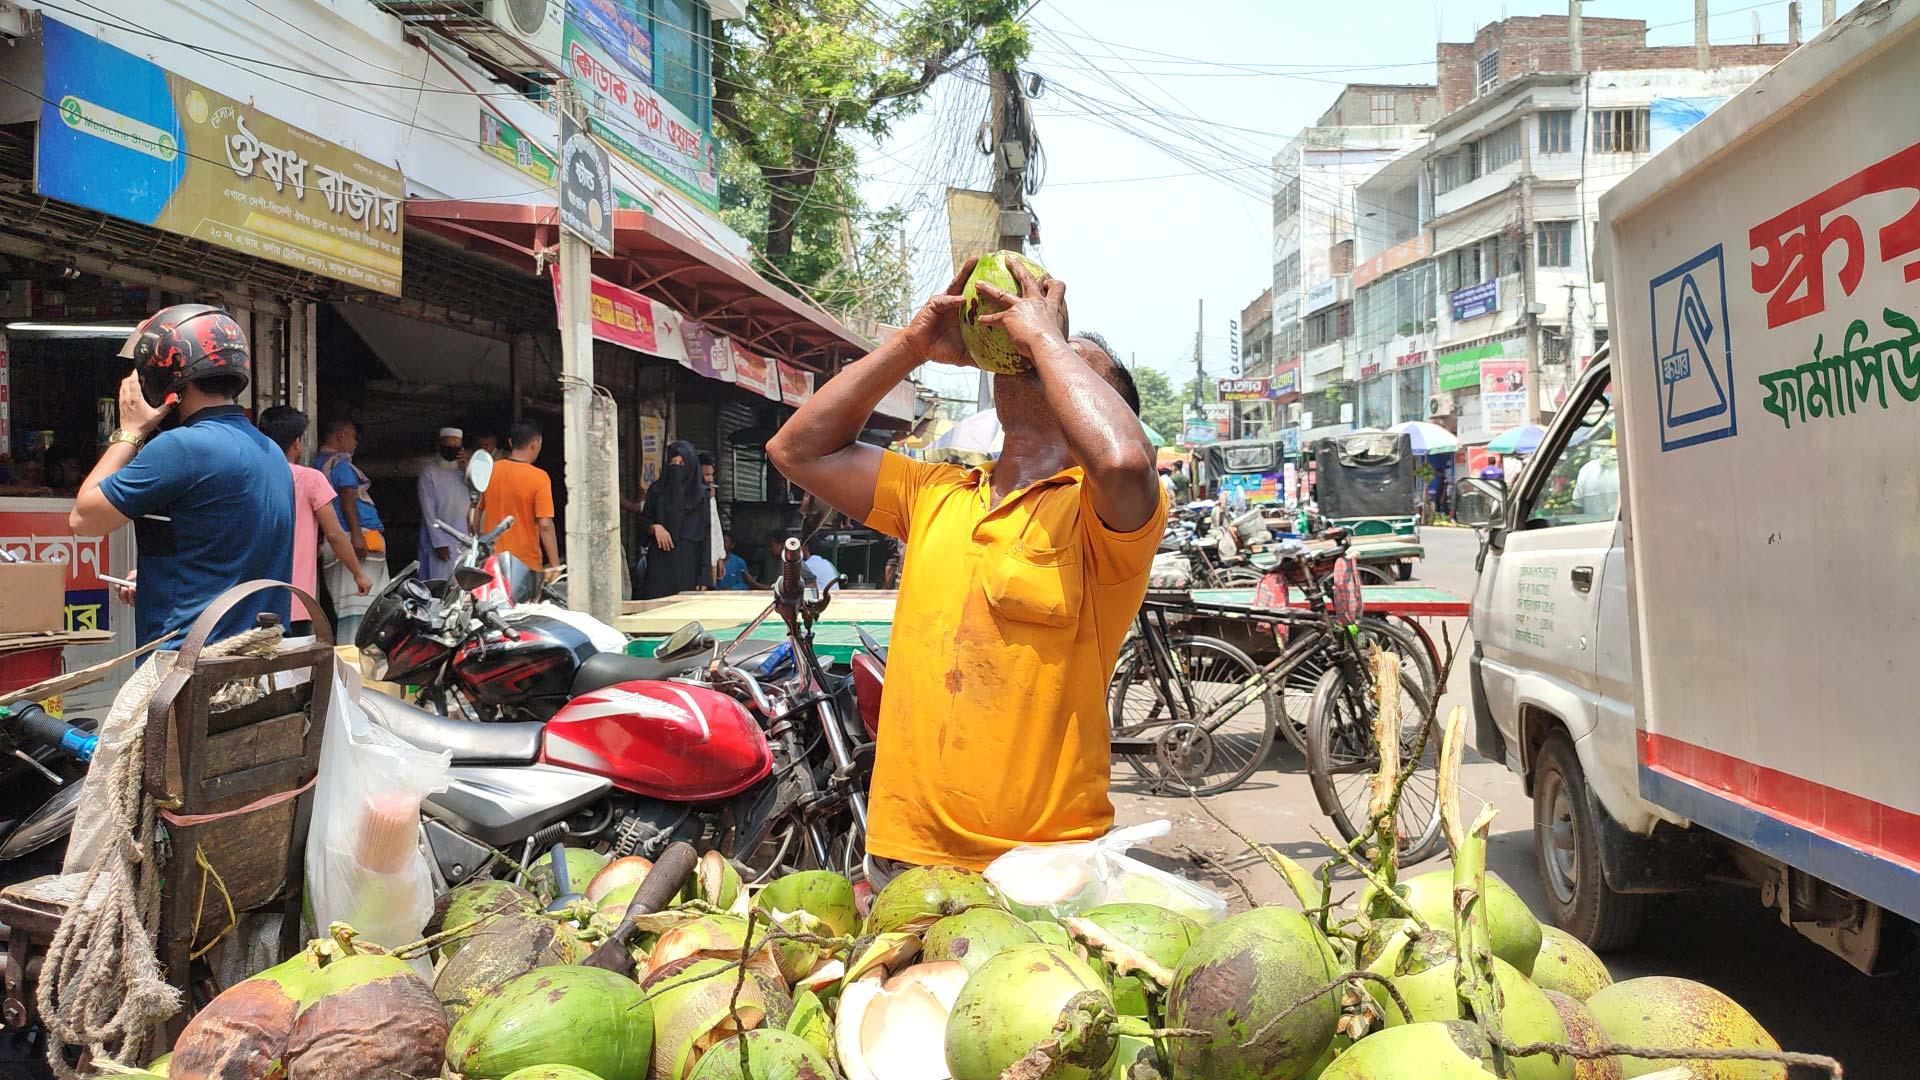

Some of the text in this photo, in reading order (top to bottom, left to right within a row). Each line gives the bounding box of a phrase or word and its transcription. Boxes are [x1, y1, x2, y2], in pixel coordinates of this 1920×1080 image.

[570, 39, 628, 105] কোডাক
[84, 116, 156, 151] Medicine Shop
[224, 115, 402, 235] ঔষধ বাজার
[1230, 319, 1239, 363] LOTTO
